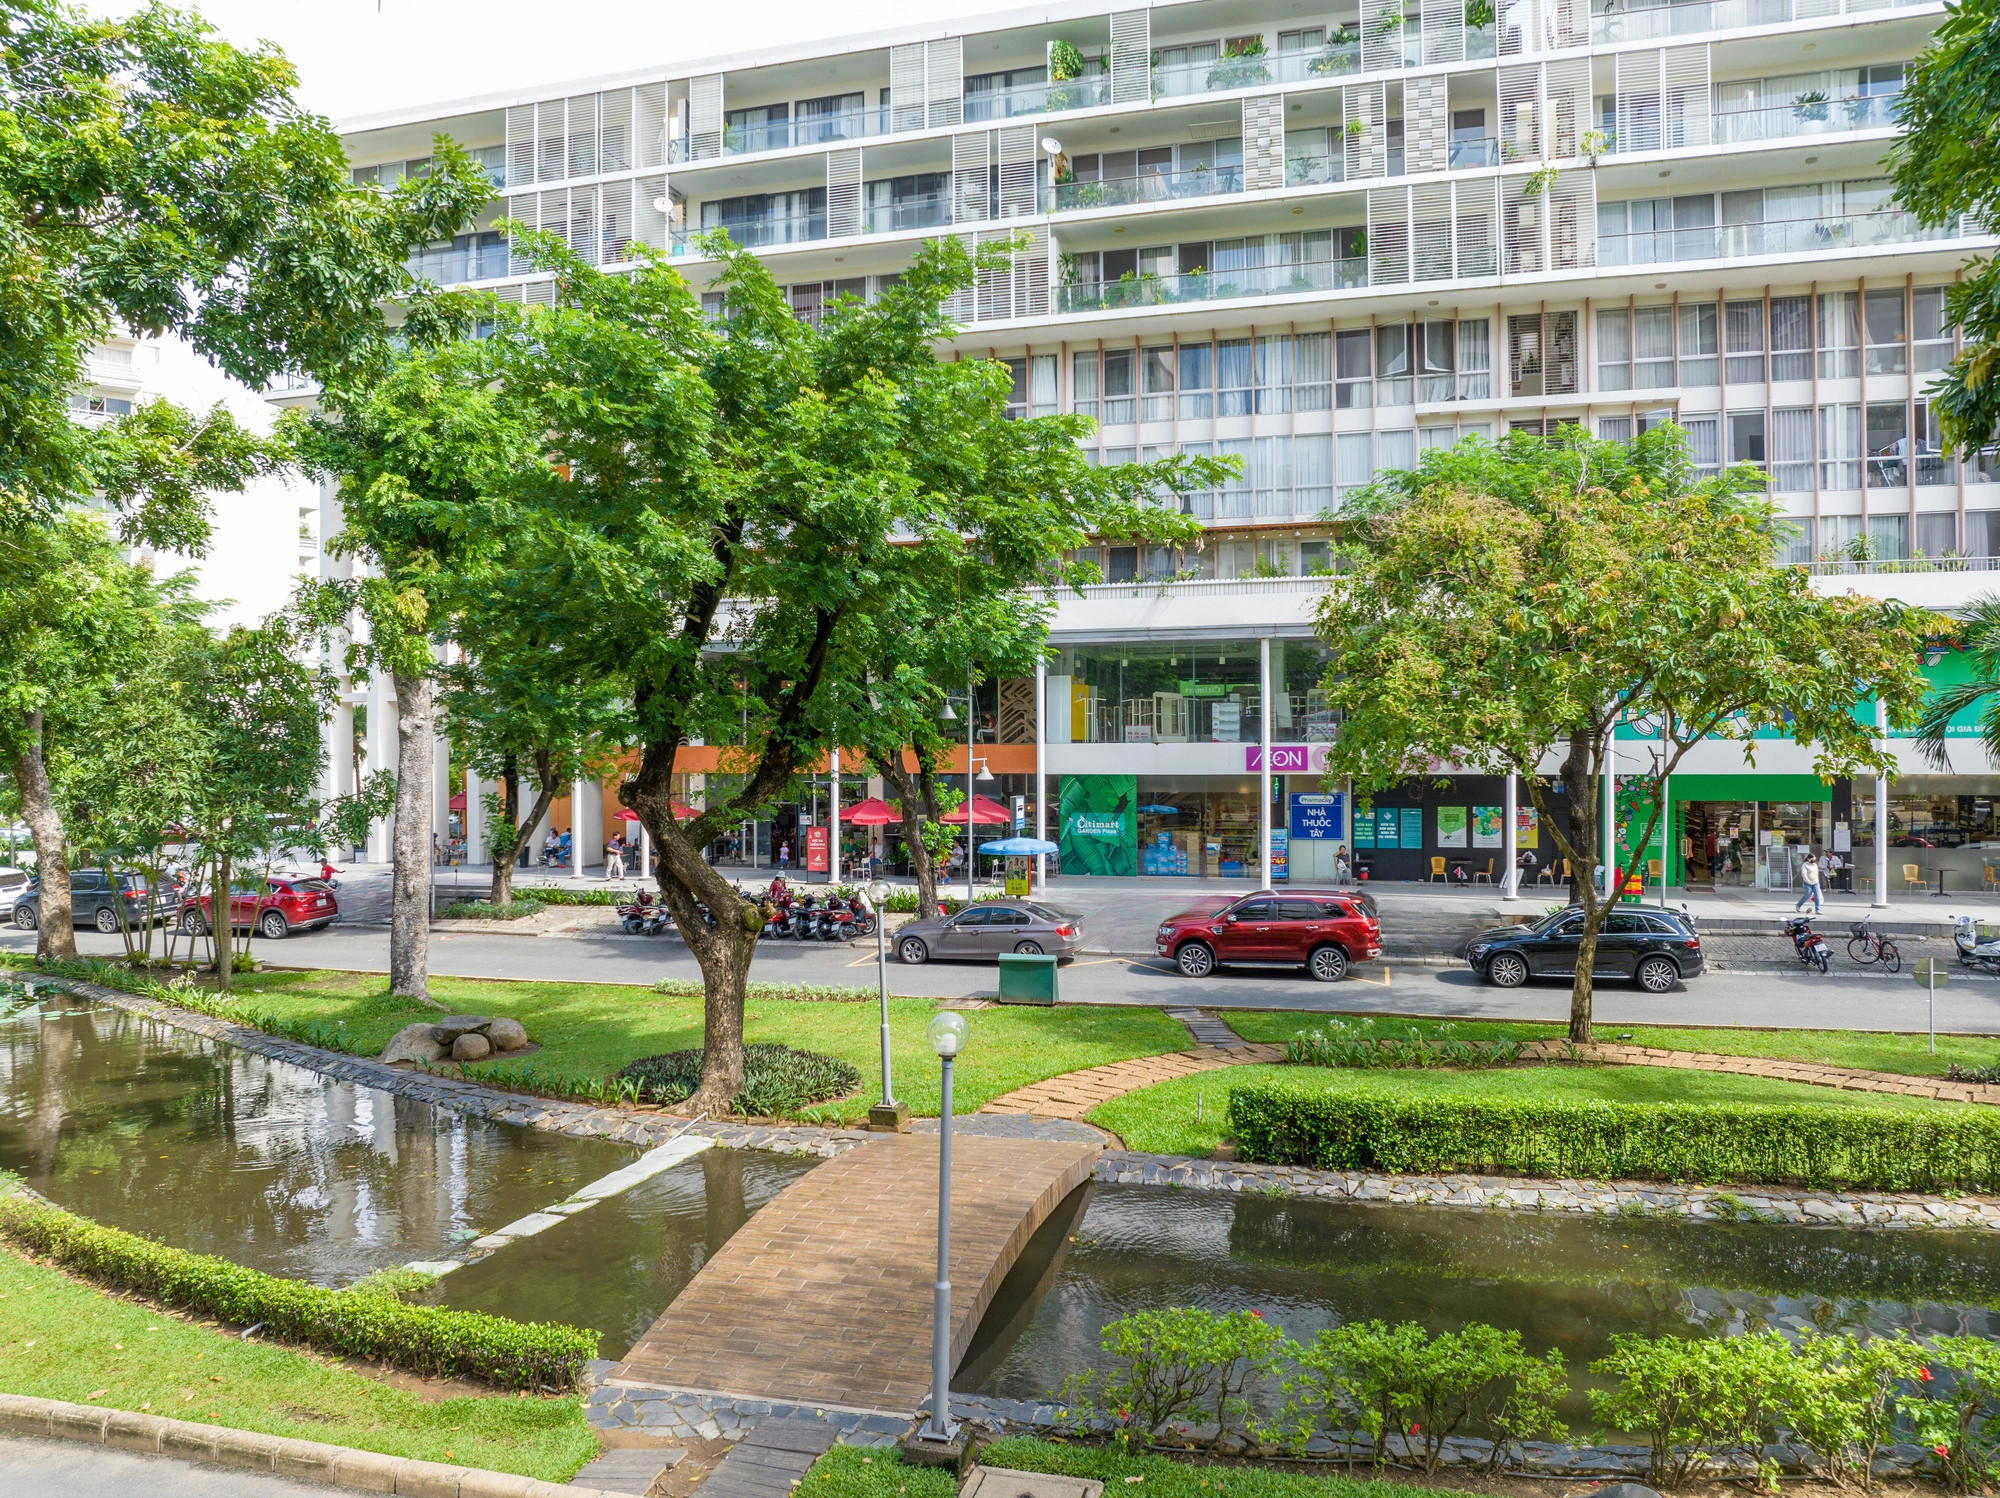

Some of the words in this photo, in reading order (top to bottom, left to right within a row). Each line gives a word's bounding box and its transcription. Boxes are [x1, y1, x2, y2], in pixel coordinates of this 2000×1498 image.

[1307, 806, 1326, 816] NHÀ
[1077, 815, 1119, 828] Citimart
[1302, 816, 1332, 827] THUỐC
[1309, 828, 1324, 838] TÂY
